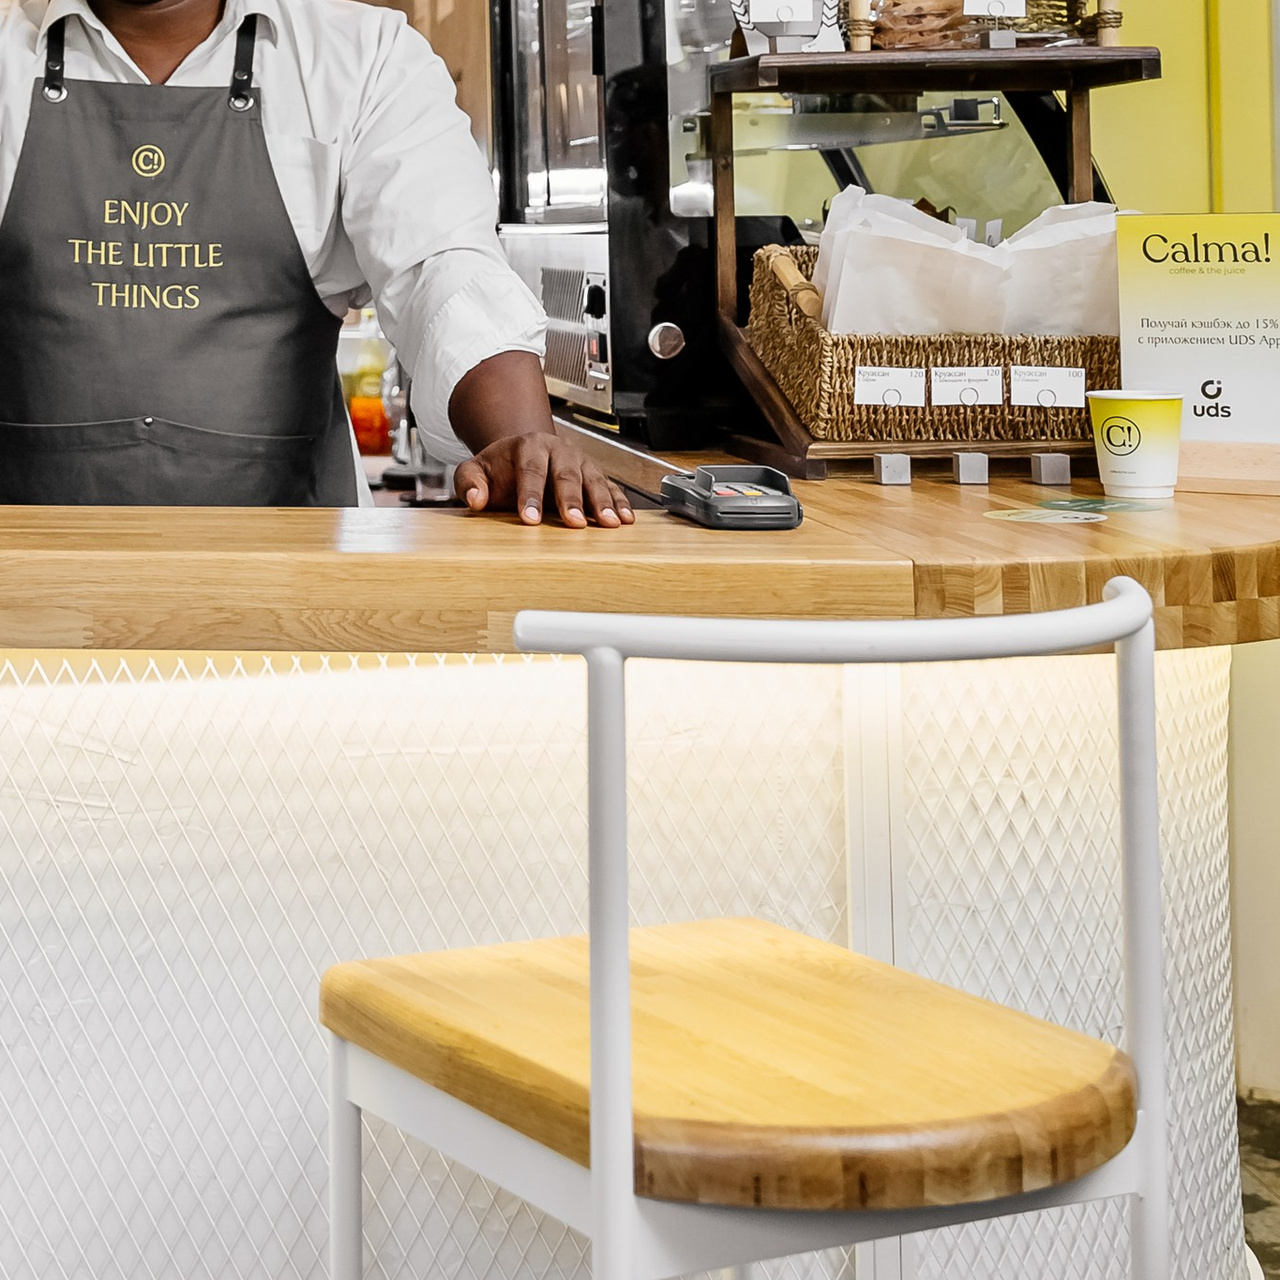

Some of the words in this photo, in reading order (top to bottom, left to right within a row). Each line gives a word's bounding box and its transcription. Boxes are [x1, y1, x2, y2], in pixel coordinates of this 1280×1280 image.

[104, 199, 189, 230] ENJOY
[68, 239, 124, 266] THE
[133, 243, 223, 268] LITTLE
[1142, 232, 1271, 263] Calma!
[1169, 266, 1197, 275] coffee
[1198, 266, 1205, 275] &
[1206, 266, 1222, 275] the
[1223, 266, 1246, 276] juice
[91, 282, 200, 309] THINGS
[1141, 318, 1188, 332] Получай
[1191, 318, 1233, 330] кэшбэк
[1235, 319, 1251, 332] до
[1256, 318, 1279, 330] 15%
[1138, 336, 1144, 345] с
[1147, 335, 1225, 348] приложением
[1229, 334, 1256, 346] UDS
[858, 369, 890, 378] Круассан
[910, 370, 924, 378] 120
[934, 370, 966, 379] Круассан
[986, 369, 1000, 377] 120
[1014, 369, 1047, 378] Круассан
[1068, 370, 1083, 378] 100
[1193, 402, 1232, 418] uds
[1106, 424, 1133, 448] C!
